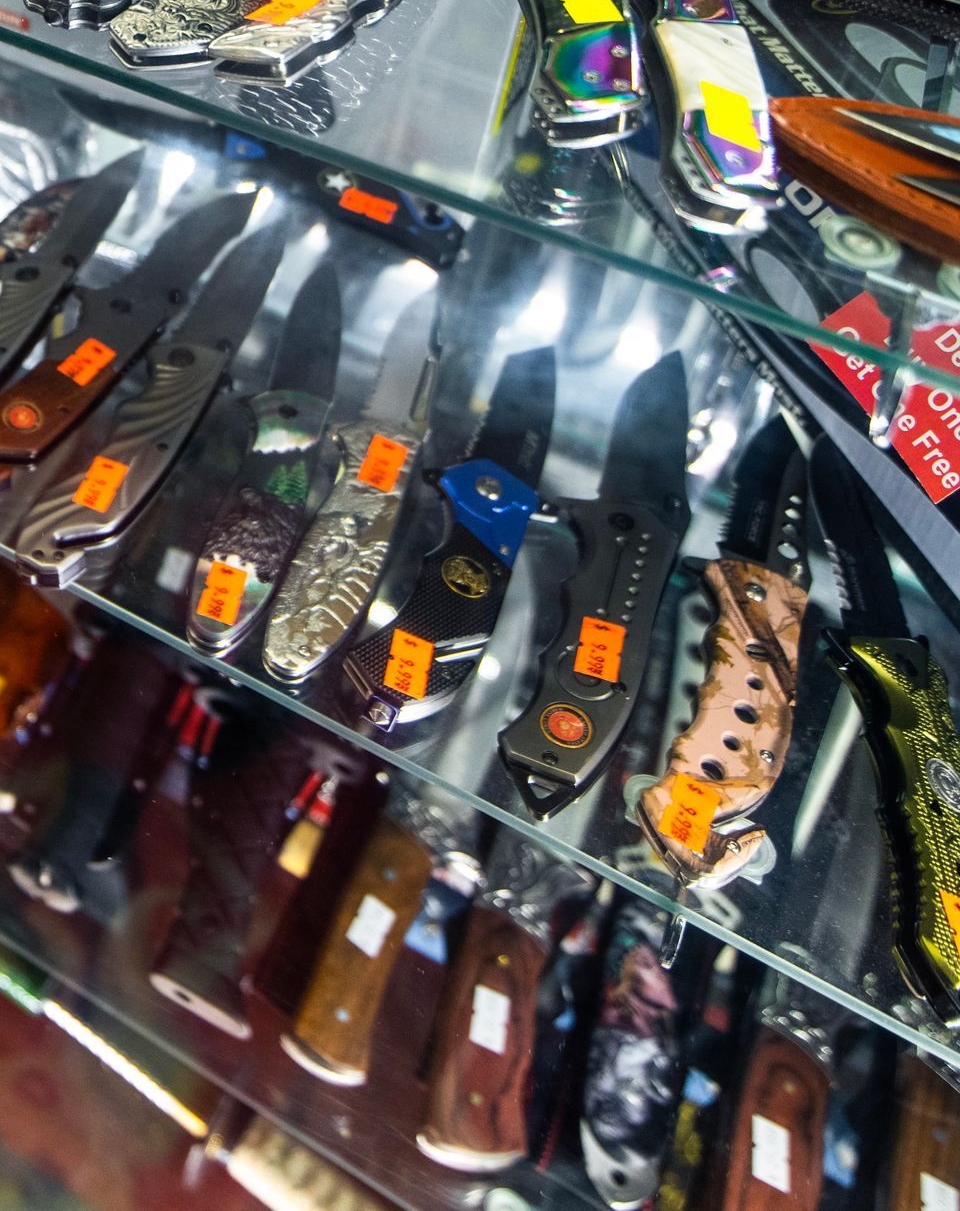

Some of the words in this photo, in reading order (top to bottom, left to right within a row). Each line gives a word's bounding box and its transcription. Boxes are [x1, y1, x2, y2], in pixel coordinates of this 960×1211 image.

[911, 428, 960, 490] Free
[593, 623, 612, 632] $
[403, 638, 419, 648] $
[686, 782, 705, 796] $
